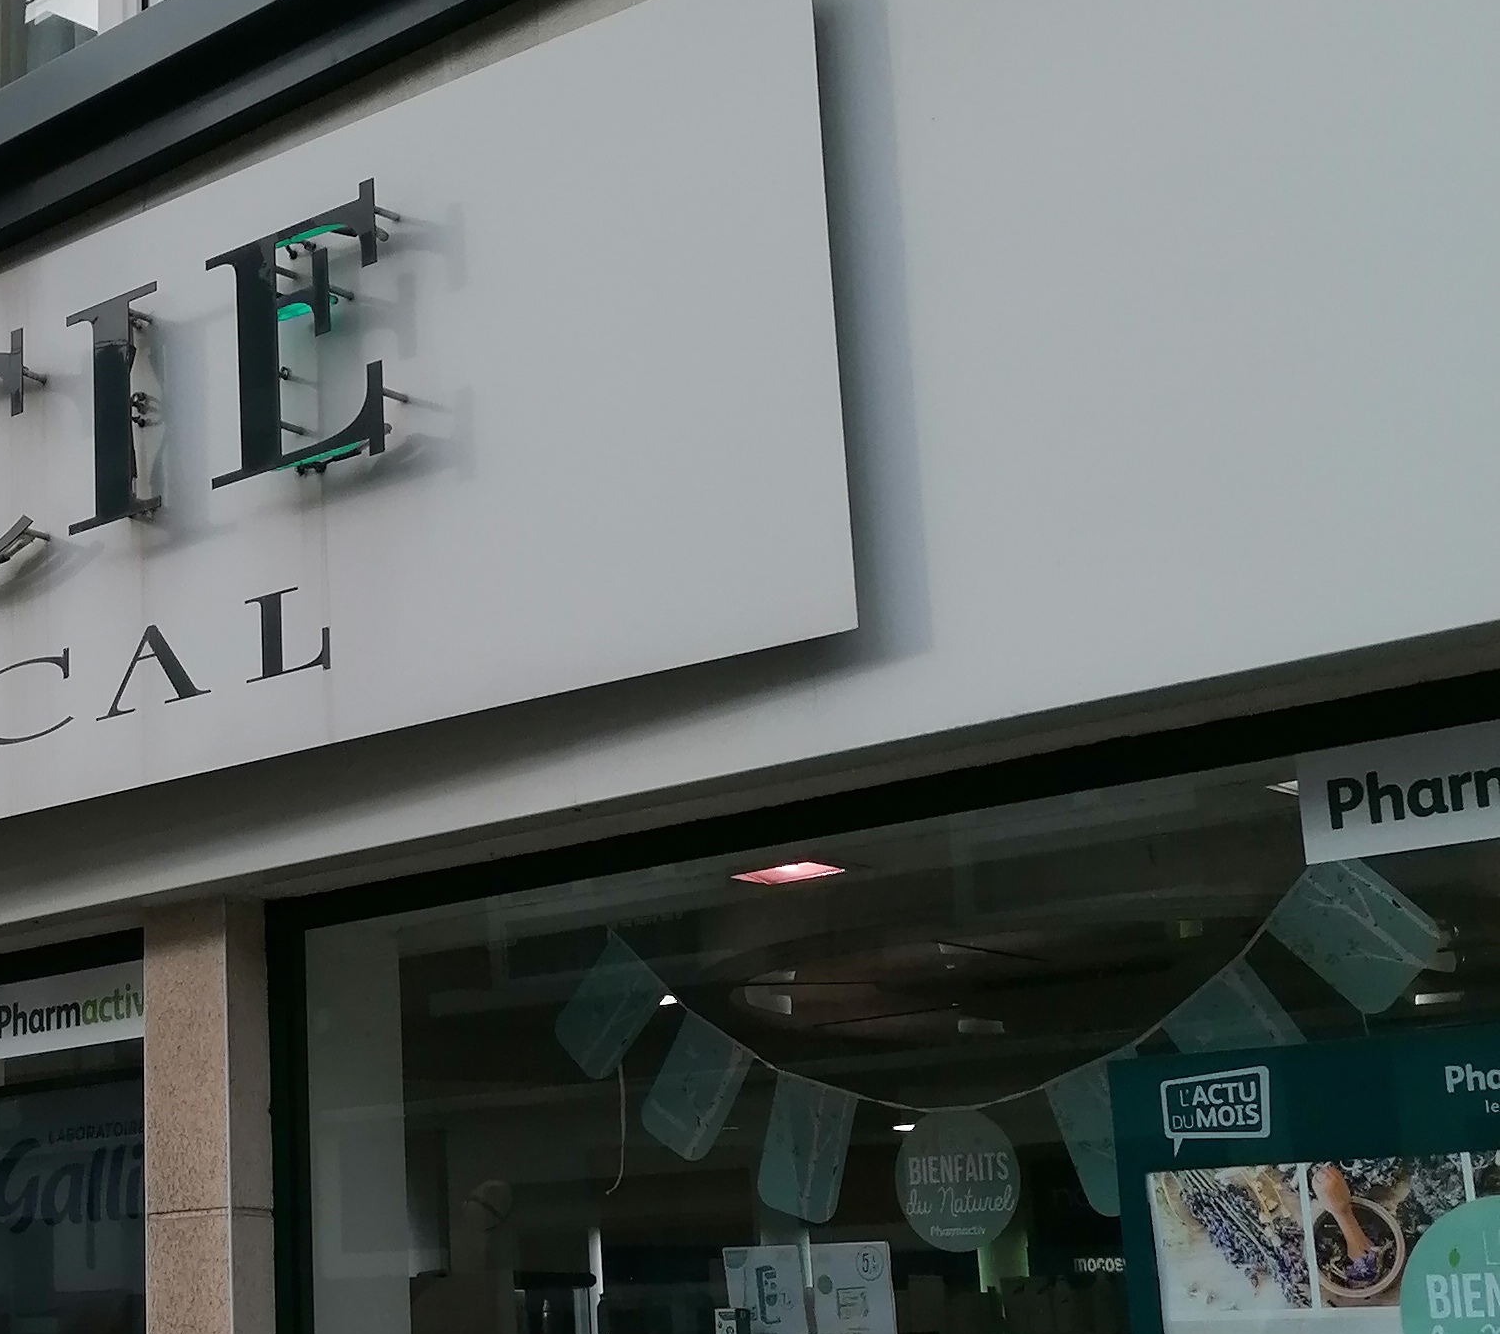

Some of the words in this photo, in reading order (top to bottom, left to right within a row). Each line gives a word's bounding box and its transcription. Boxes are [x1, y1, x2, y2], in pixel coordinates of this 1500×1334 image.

[1172, 1114, 1195, 1130] DU
[1196, 1103, 1261, 1129] MOIS
[906, 1151, 1010, 1186] BIENFAITS
[905, 1187, 932, 1216] du
[938, 1183, 1016, 1218] Naturel
